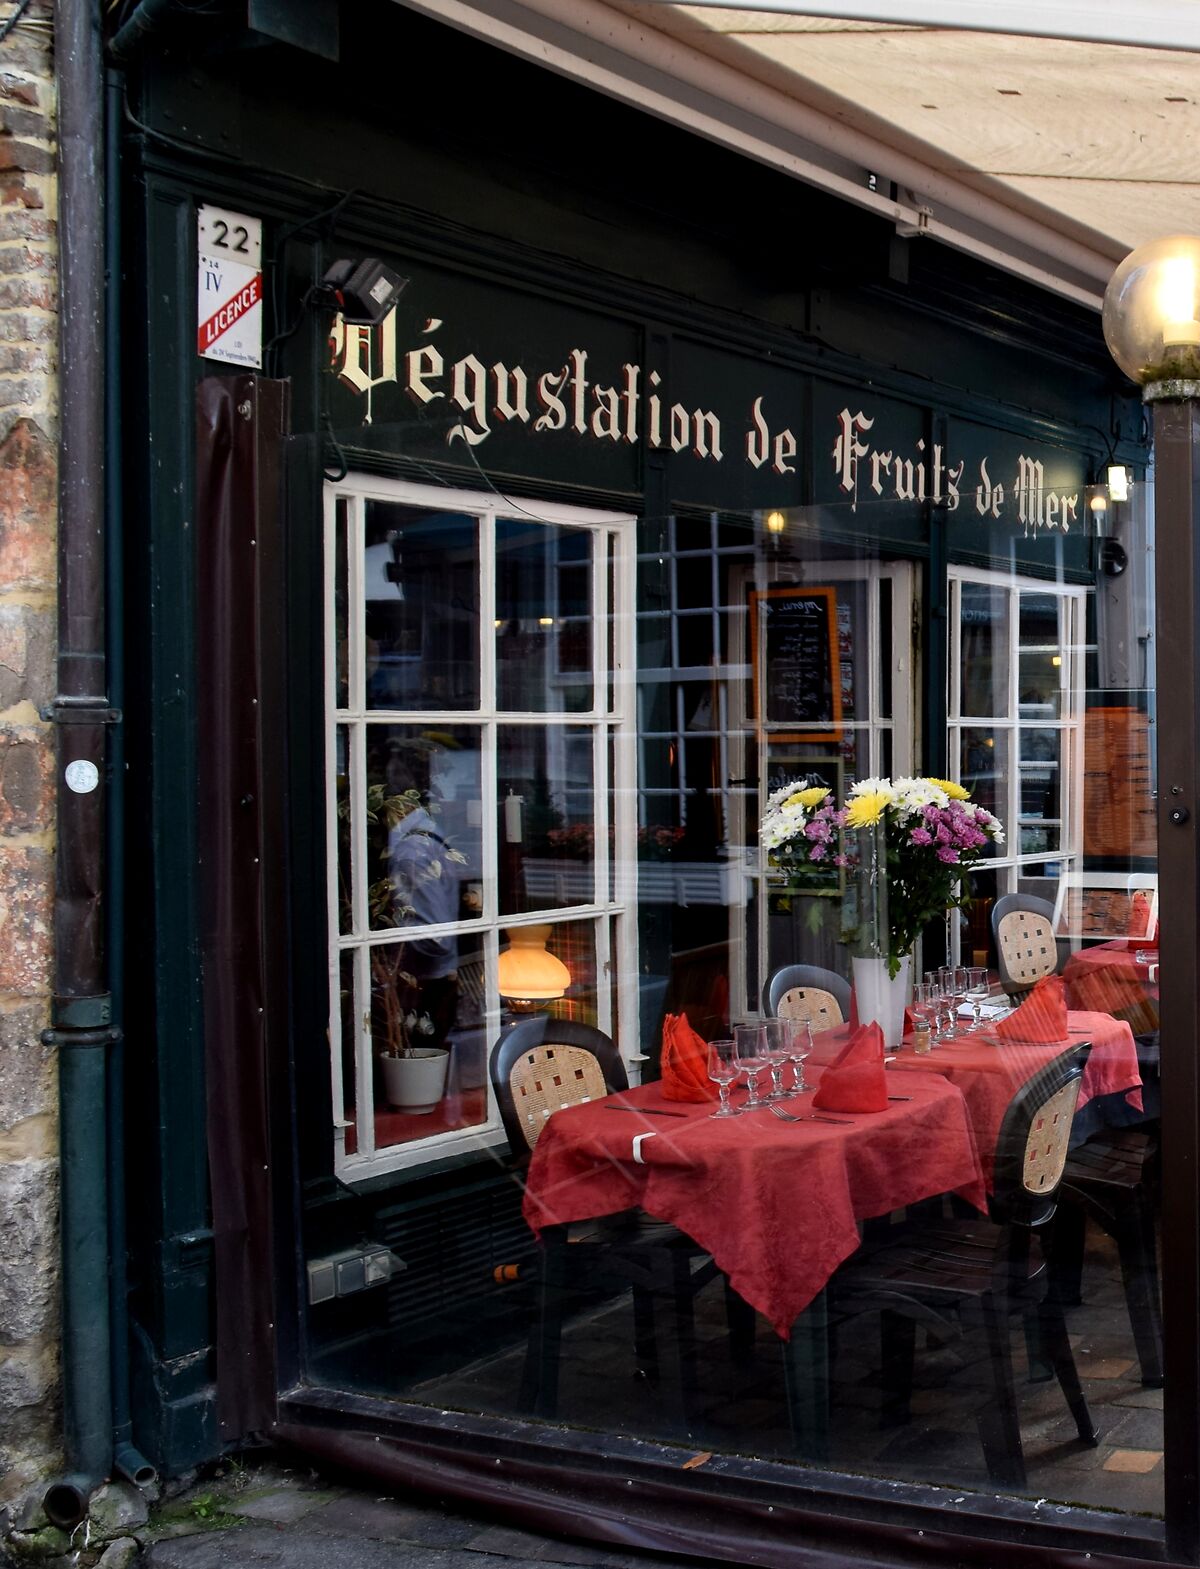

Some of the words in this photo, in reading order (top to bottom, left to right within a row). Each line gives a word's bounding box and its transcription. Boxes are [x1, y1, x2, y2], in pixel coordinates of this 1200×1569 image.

[212, 220, 249, 253] 22
[206, 271, 223, 293] IV
[207, 281, 257, 343] LICENCE
[330, 303, 723, 462] Dégustation
[746, 396, 797, 474] de
[832, 407, 964, 513] Fruits
[976, 456, 1005, 518] de
[1013, 453, 1079, 540] Mer
